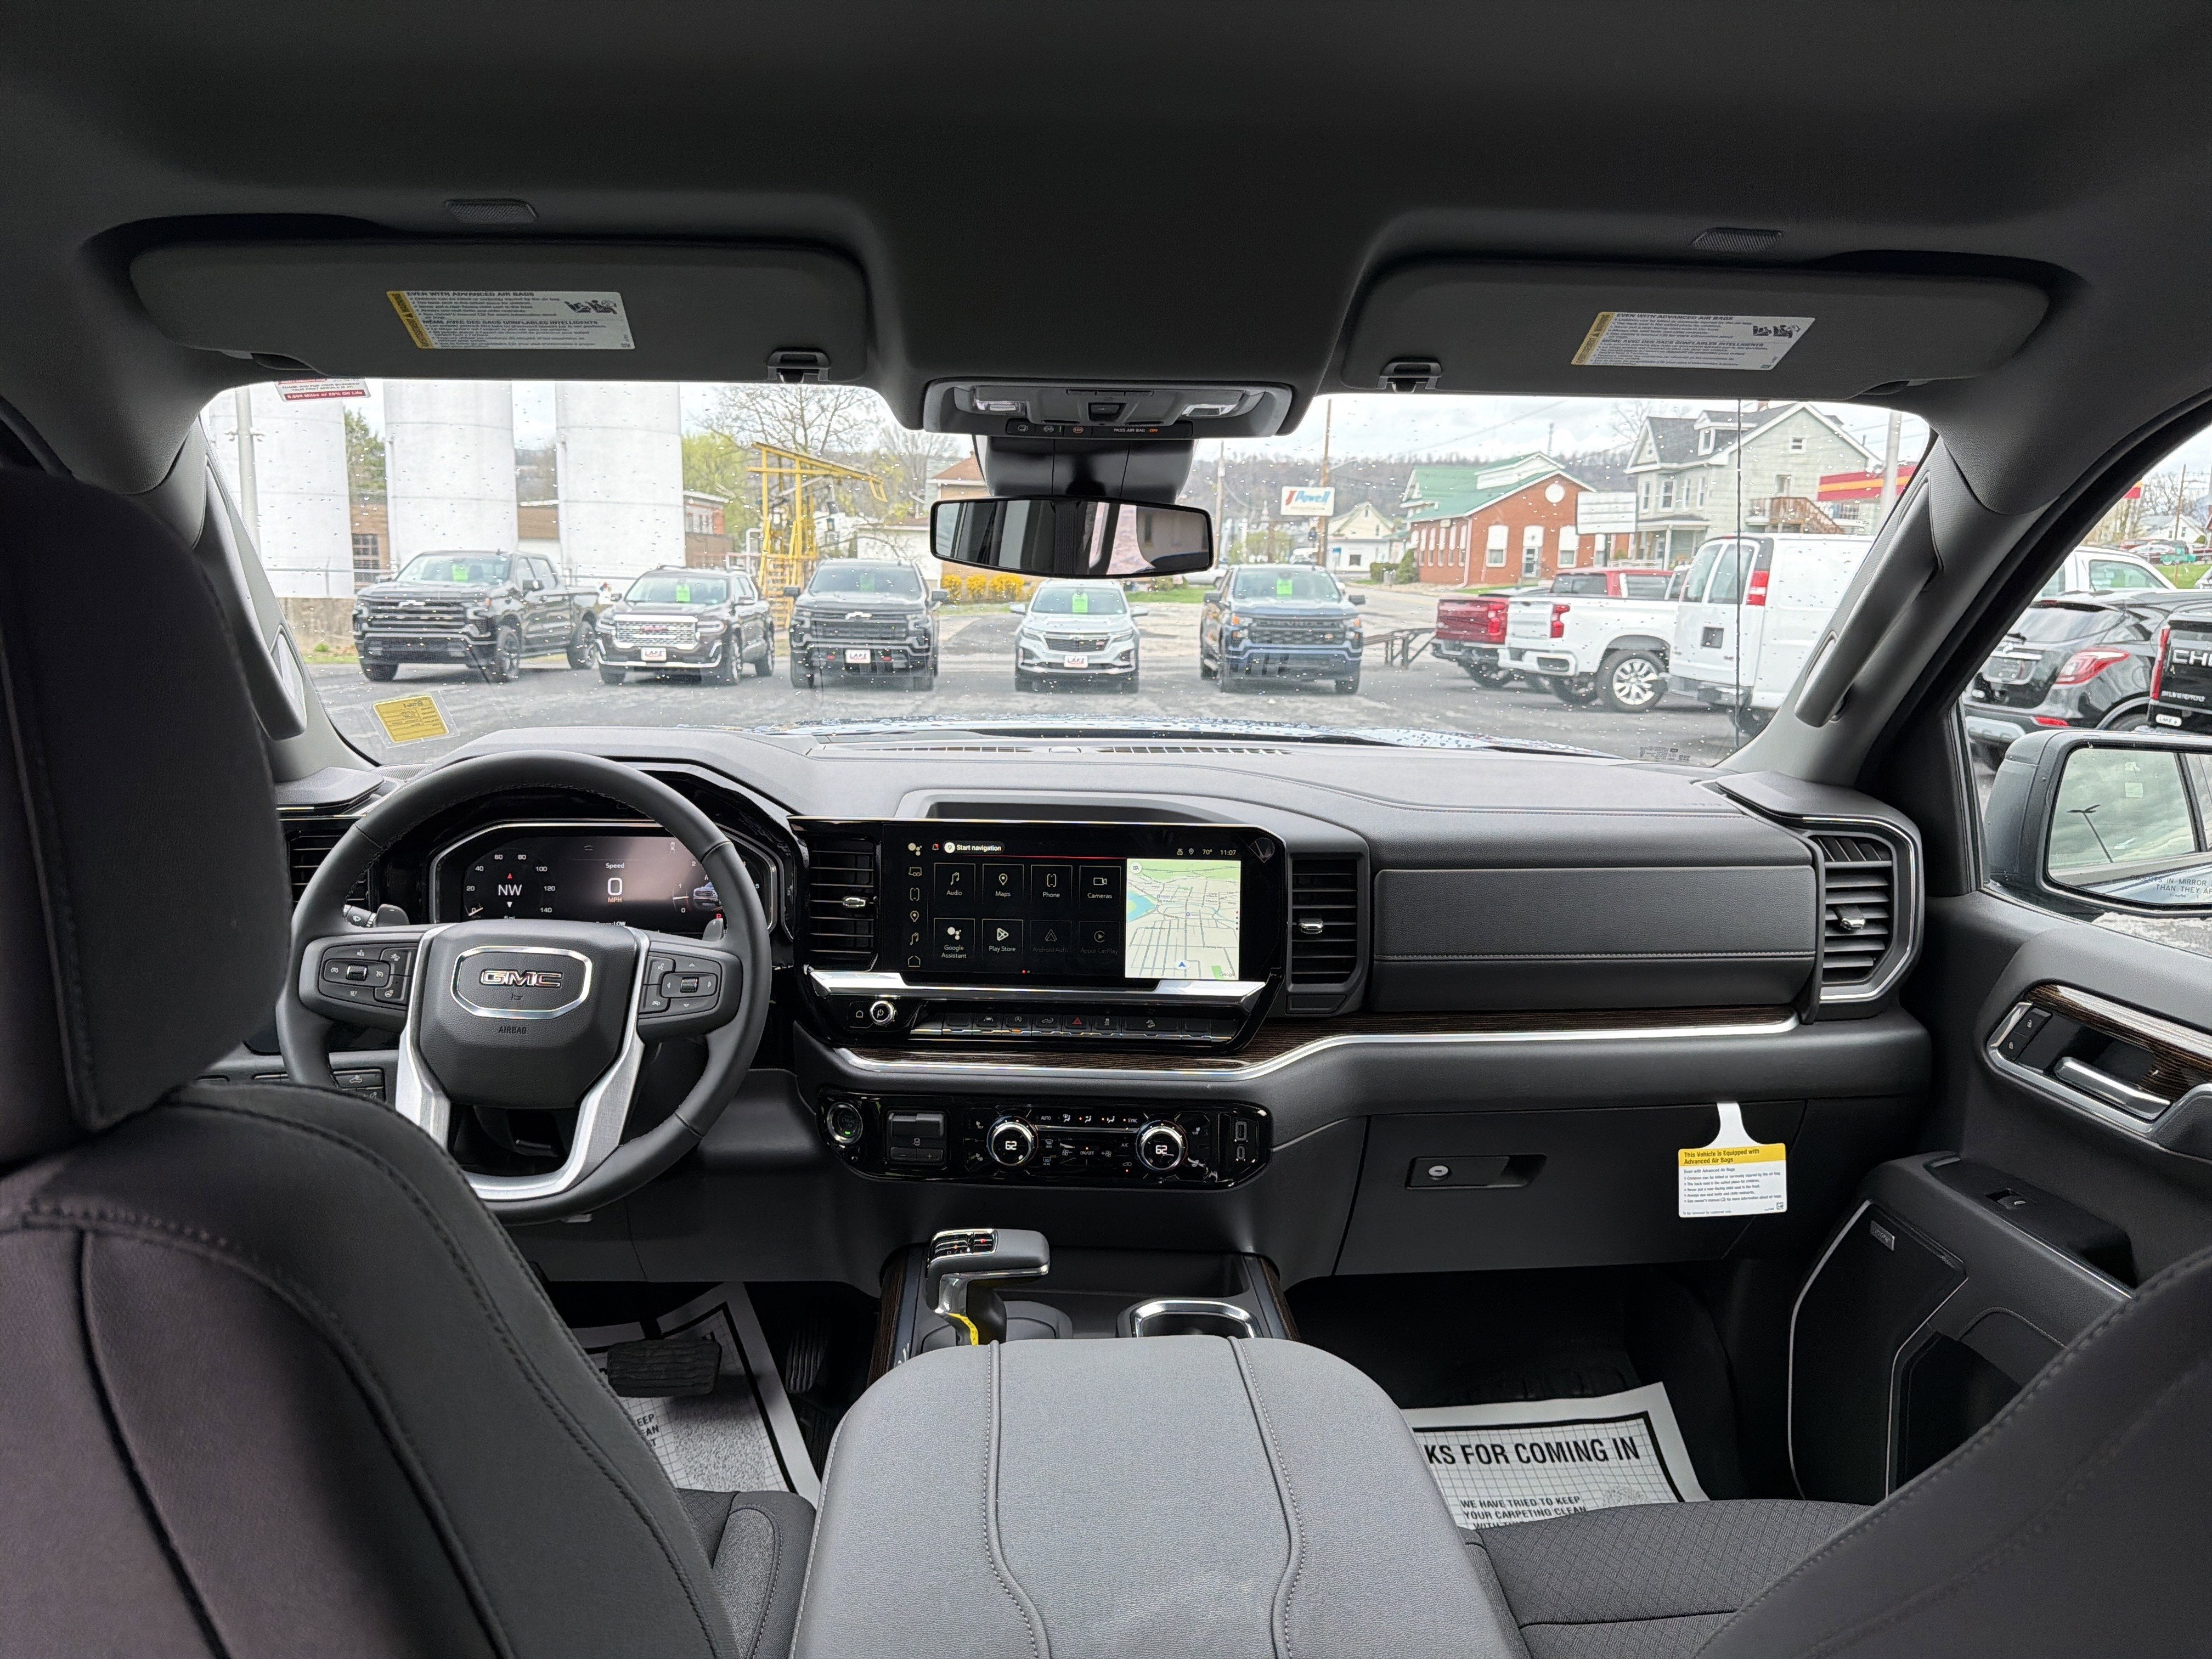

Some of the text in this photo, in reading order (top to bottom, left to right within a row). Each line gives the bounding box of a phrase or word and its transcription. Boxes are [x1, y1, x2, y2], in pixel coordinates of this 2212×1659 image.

[1294, 490, 1331, 503] Powell
[2172, 649, 2212, 667] CH
[972, 844, 1002, 853] navigation
[607, 877, 623, 896] 0
[2179, 878, 2207, 886] MIRROR
[498, 884, 522, 896] NW
[989, 945, 1000, 953] Play
[479, 969, 563, 989] GMC
[498, 1025, 527, 1034] AIRBAG
[1005, 1141, 1017, 1150] 62
[1155, 1144, 1167, 1154] 62
[1460, 1443, 1510, 1465] FOR
[1514, 1438, 1609, 1464] COMING
[1611, 1436, 1640, 1460] IN
[1460, 1496, 1581, 1508] WE HAVE TRIED TO KEEP
[1463, 1511, 1493, 1520] YOUR
[1495, 1508, 1553, 1519] CARPETING
